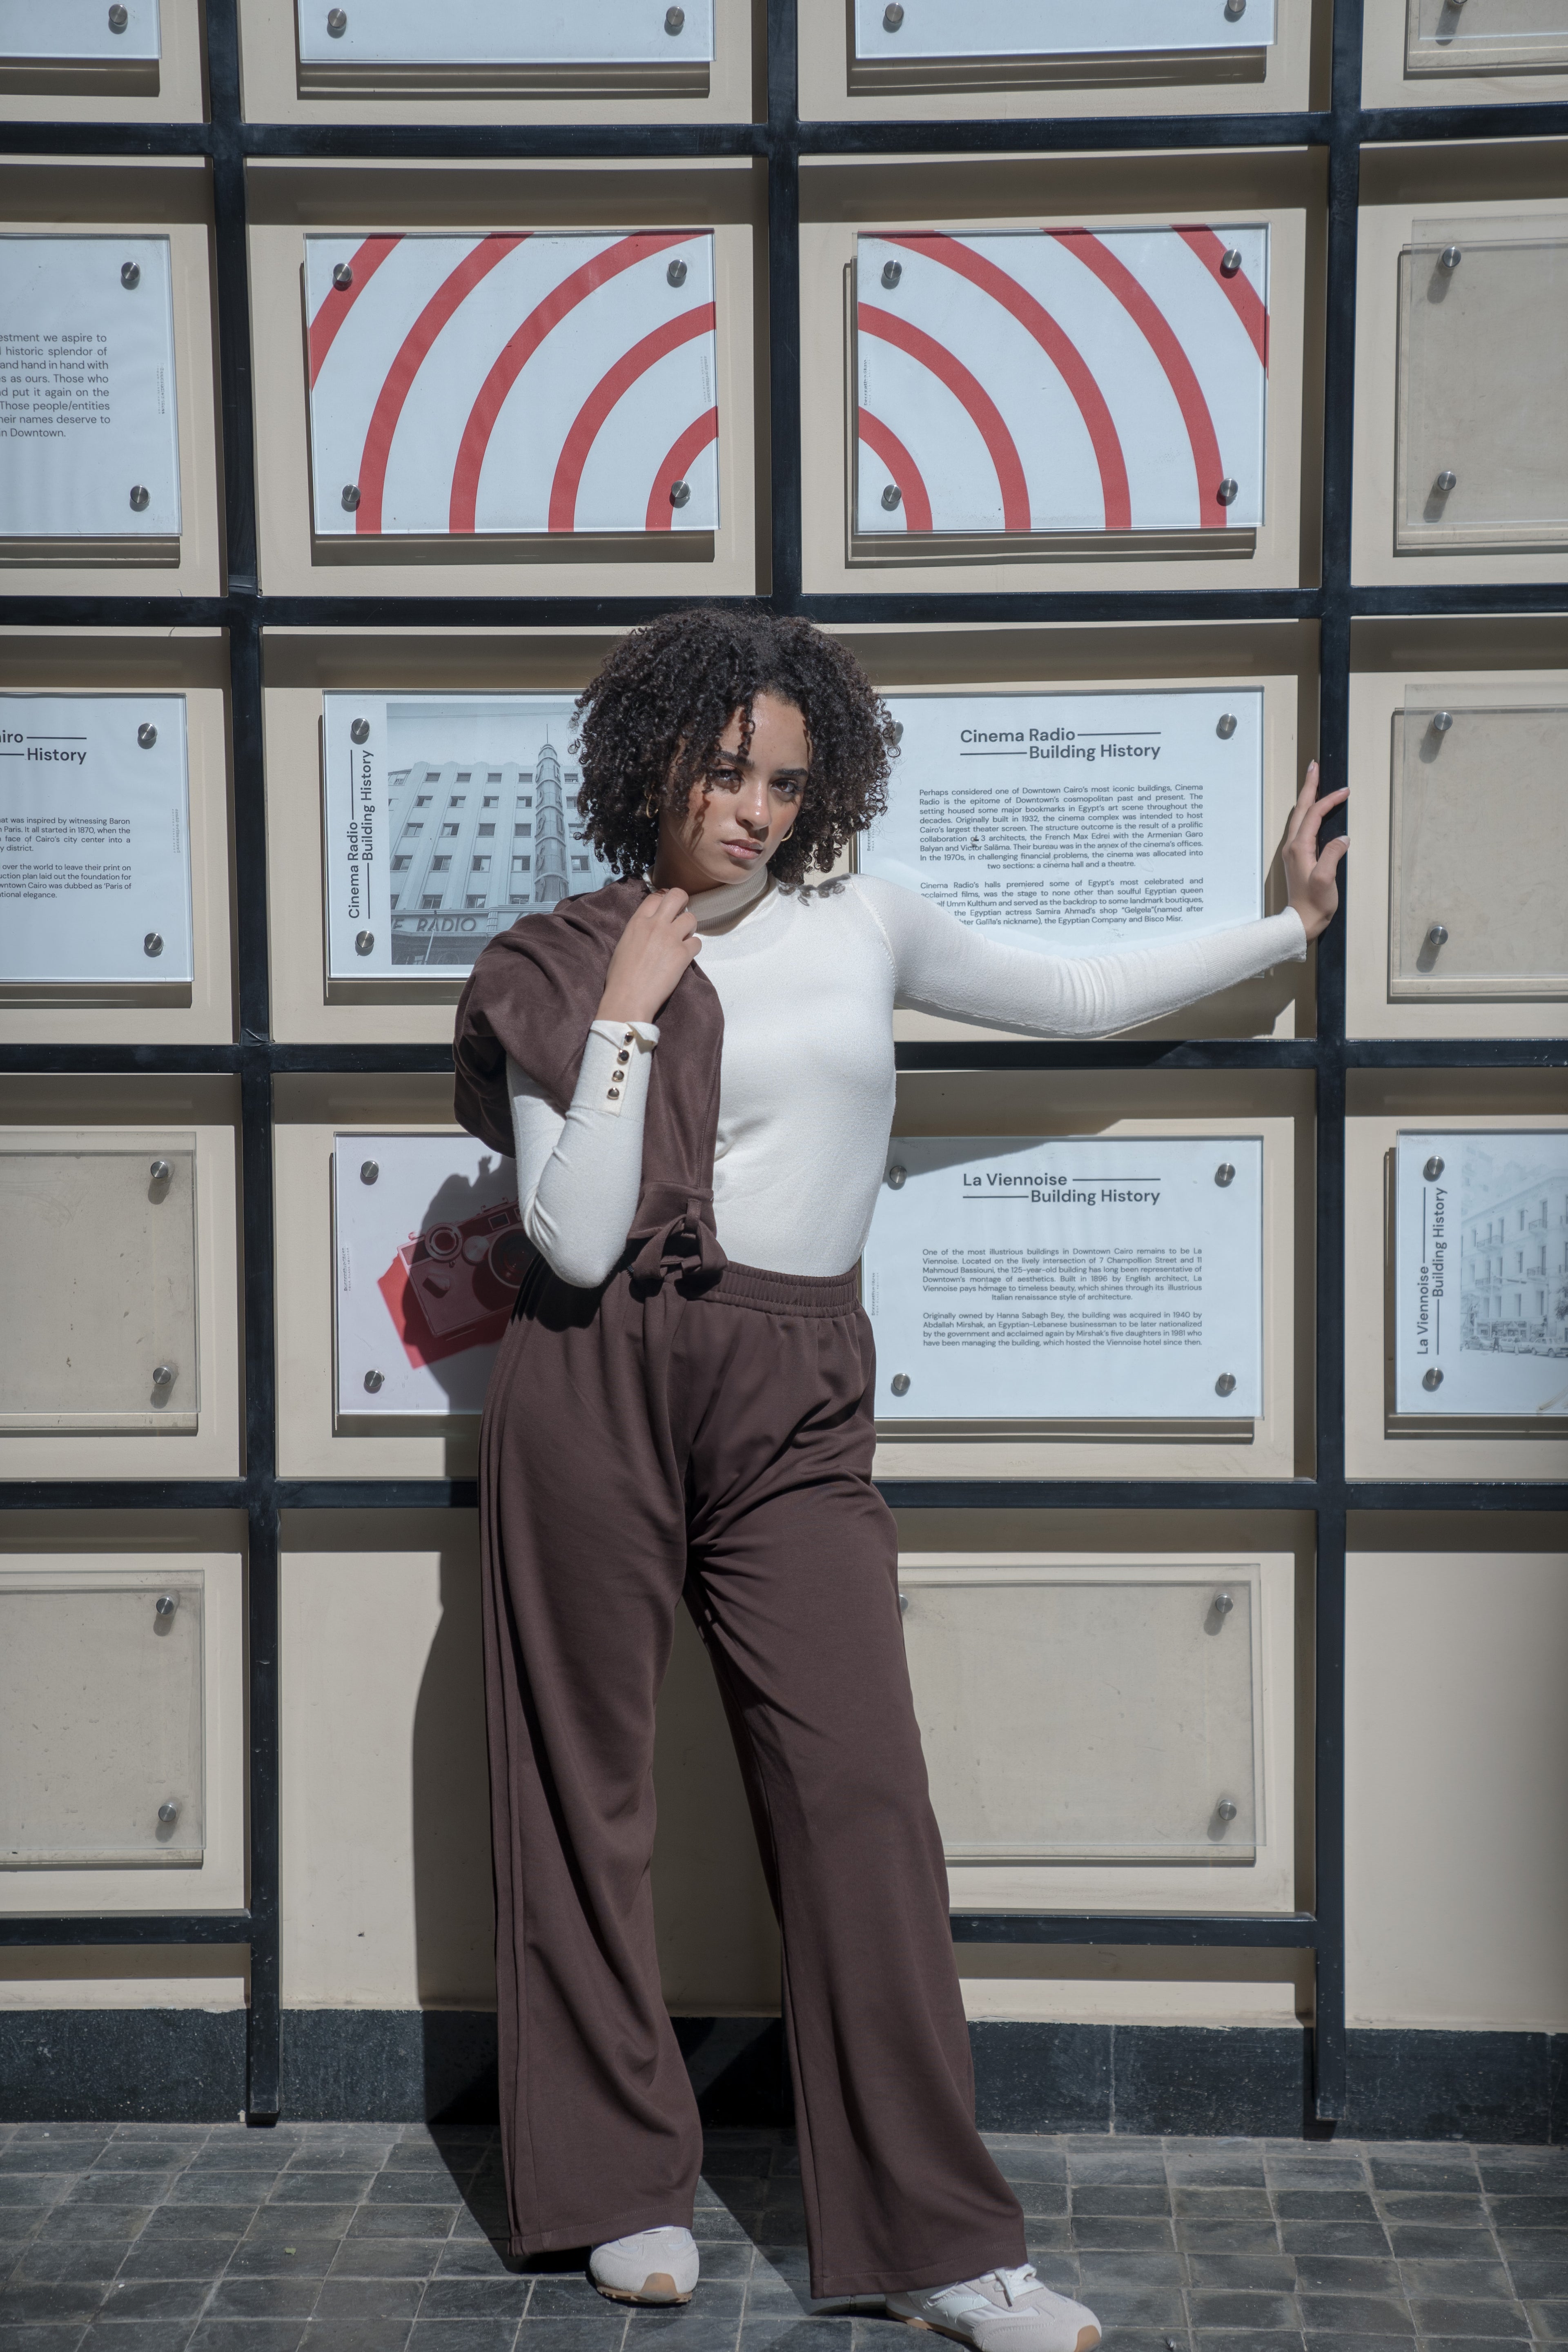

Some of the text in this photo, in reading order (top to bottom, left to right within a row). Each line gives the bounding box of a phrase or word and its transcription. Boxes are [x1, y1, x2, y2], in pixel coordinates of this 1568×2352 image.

[62, 333, 92, 344] aspire
[6, 346, 107, 358] historic splendor of
[0, 360, 108, 369] and hand in hand with
[53, 374, 84, 383] Those
[87, 374, 108, 383] who
[13, 389, 29, 399] put
[34, 388, 40, 396] it
[45, 388, 71, 399] again
[93, 388, 109, 396] the
[0, 401, 110, 412] Those people/entities
[56, 414, 97, 423] deserve
[10, 428, 66, 437] Downtown.
[0, 730, 23, 743] iro
[961, 728, 1075, 743] Cinema Radio
[27, 748, 87, 765] History
[1030, 744, 1160, 761] Building History
[1138, 784, 1172, 793] buildings,
[360, 750, 375, 860] Building History
[69, 817, 107, 826] witnessing
[956, 816, 989, 824] Originally
[1088, 814, 1119, 822] complex
[64, 836, 77, 844] city
[347, 822, 360, 918] Cinema Radio
[23, 891, 57, 900] elegance.
[416, 917, 476, 932] RADIO
[964, 1173, 1067, 1186] La Viennoise
[1031, 1189, 1160, 1206] Building History
[1432, 1187, 1448, 1297] Building History
[1027, 1248, 1059, 1256] buildings
[1417, 1266, 1429, 1354] La Viennoise
[923, 1312, 956, 1321] Originally
[1022, 1312, 1048, 1320] Sabagh
